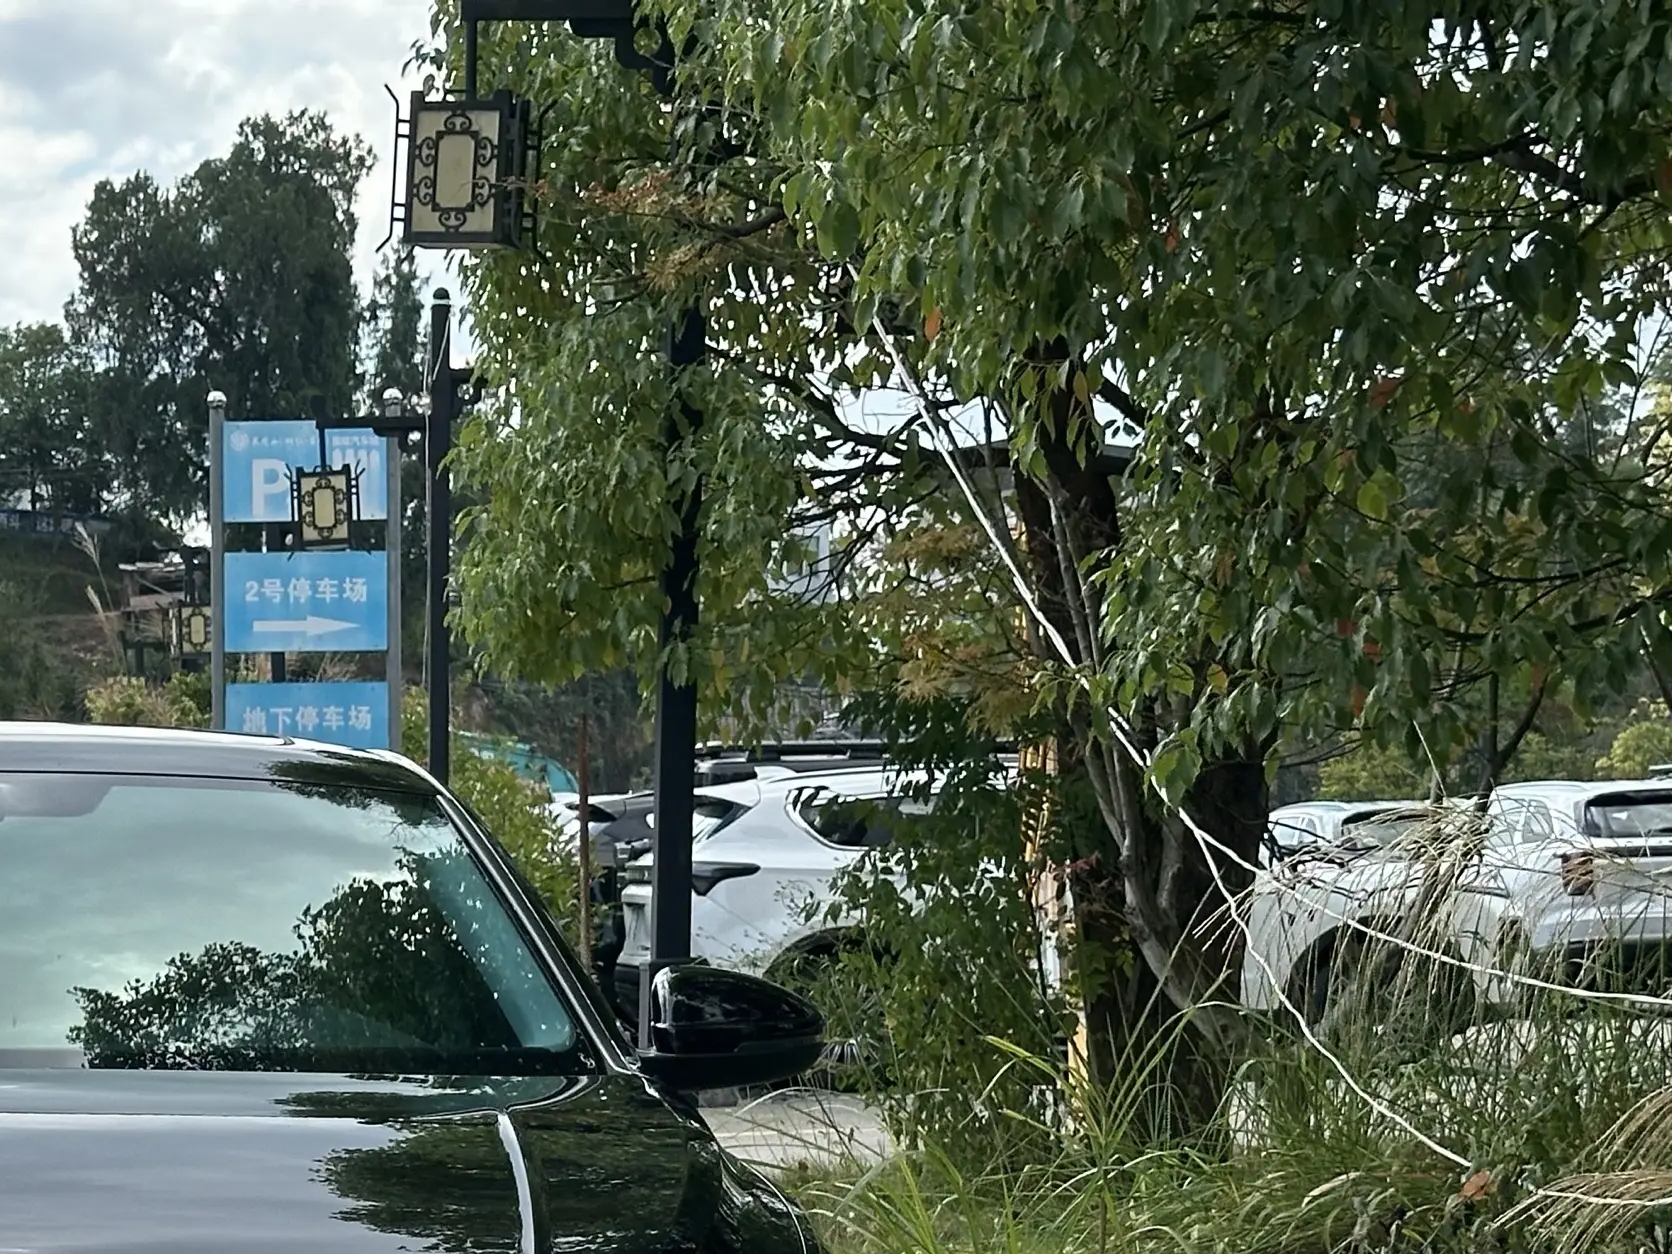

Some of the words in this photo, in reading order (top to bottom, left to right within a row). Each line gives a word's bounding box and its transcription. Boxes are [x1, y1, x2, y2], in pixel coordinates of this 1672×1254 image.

[251, 457, 290, 518] P
[245, 577, 368, 603] 2号停车场
[243, 705, 372, 734] 地下停车场
